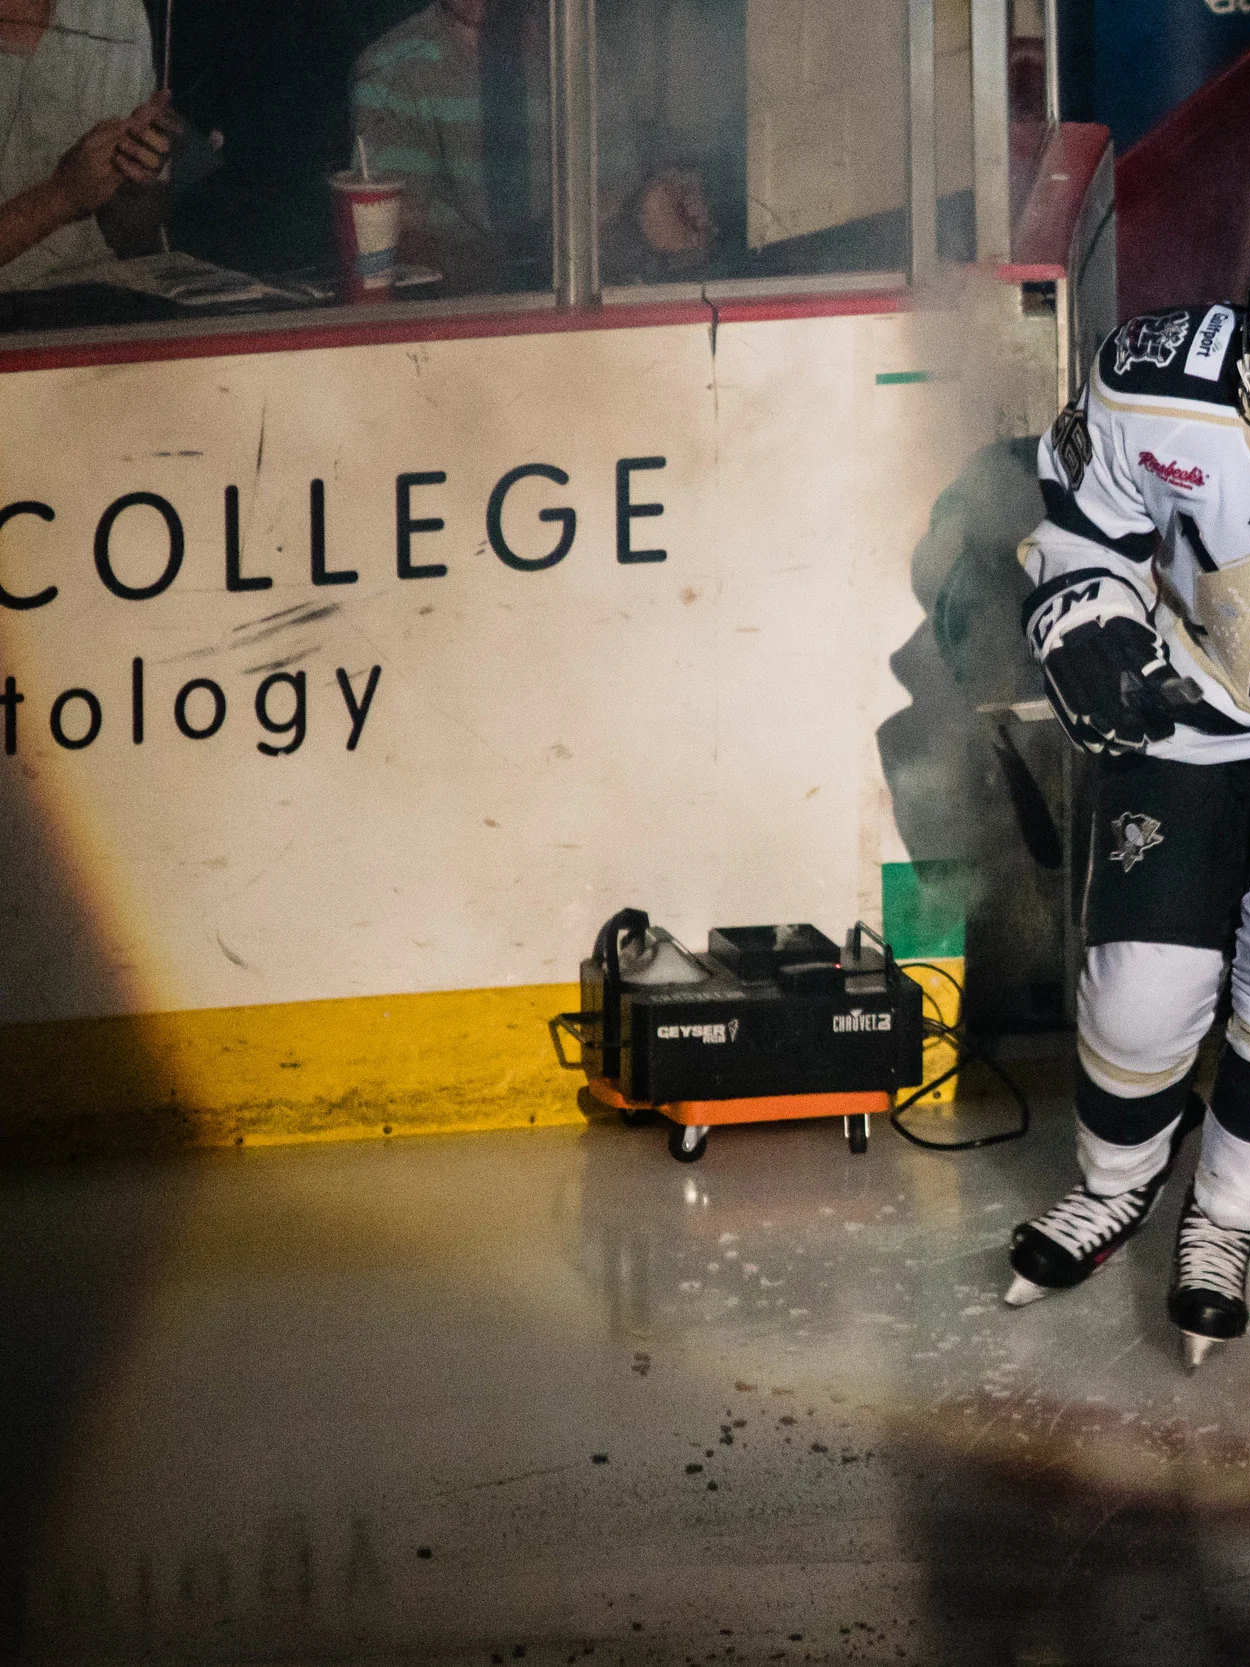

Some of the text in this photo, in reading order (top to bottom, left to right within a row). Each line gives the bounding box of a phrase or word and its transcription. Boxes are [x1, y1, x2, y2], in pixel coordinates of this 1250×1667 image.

[0, 456, 668, 611] COLLEGE
[1032, 581, 1101, 650] CM
[0, 656, 382, 757] tology
[657, 1024, 726, 1039] GEYSER
